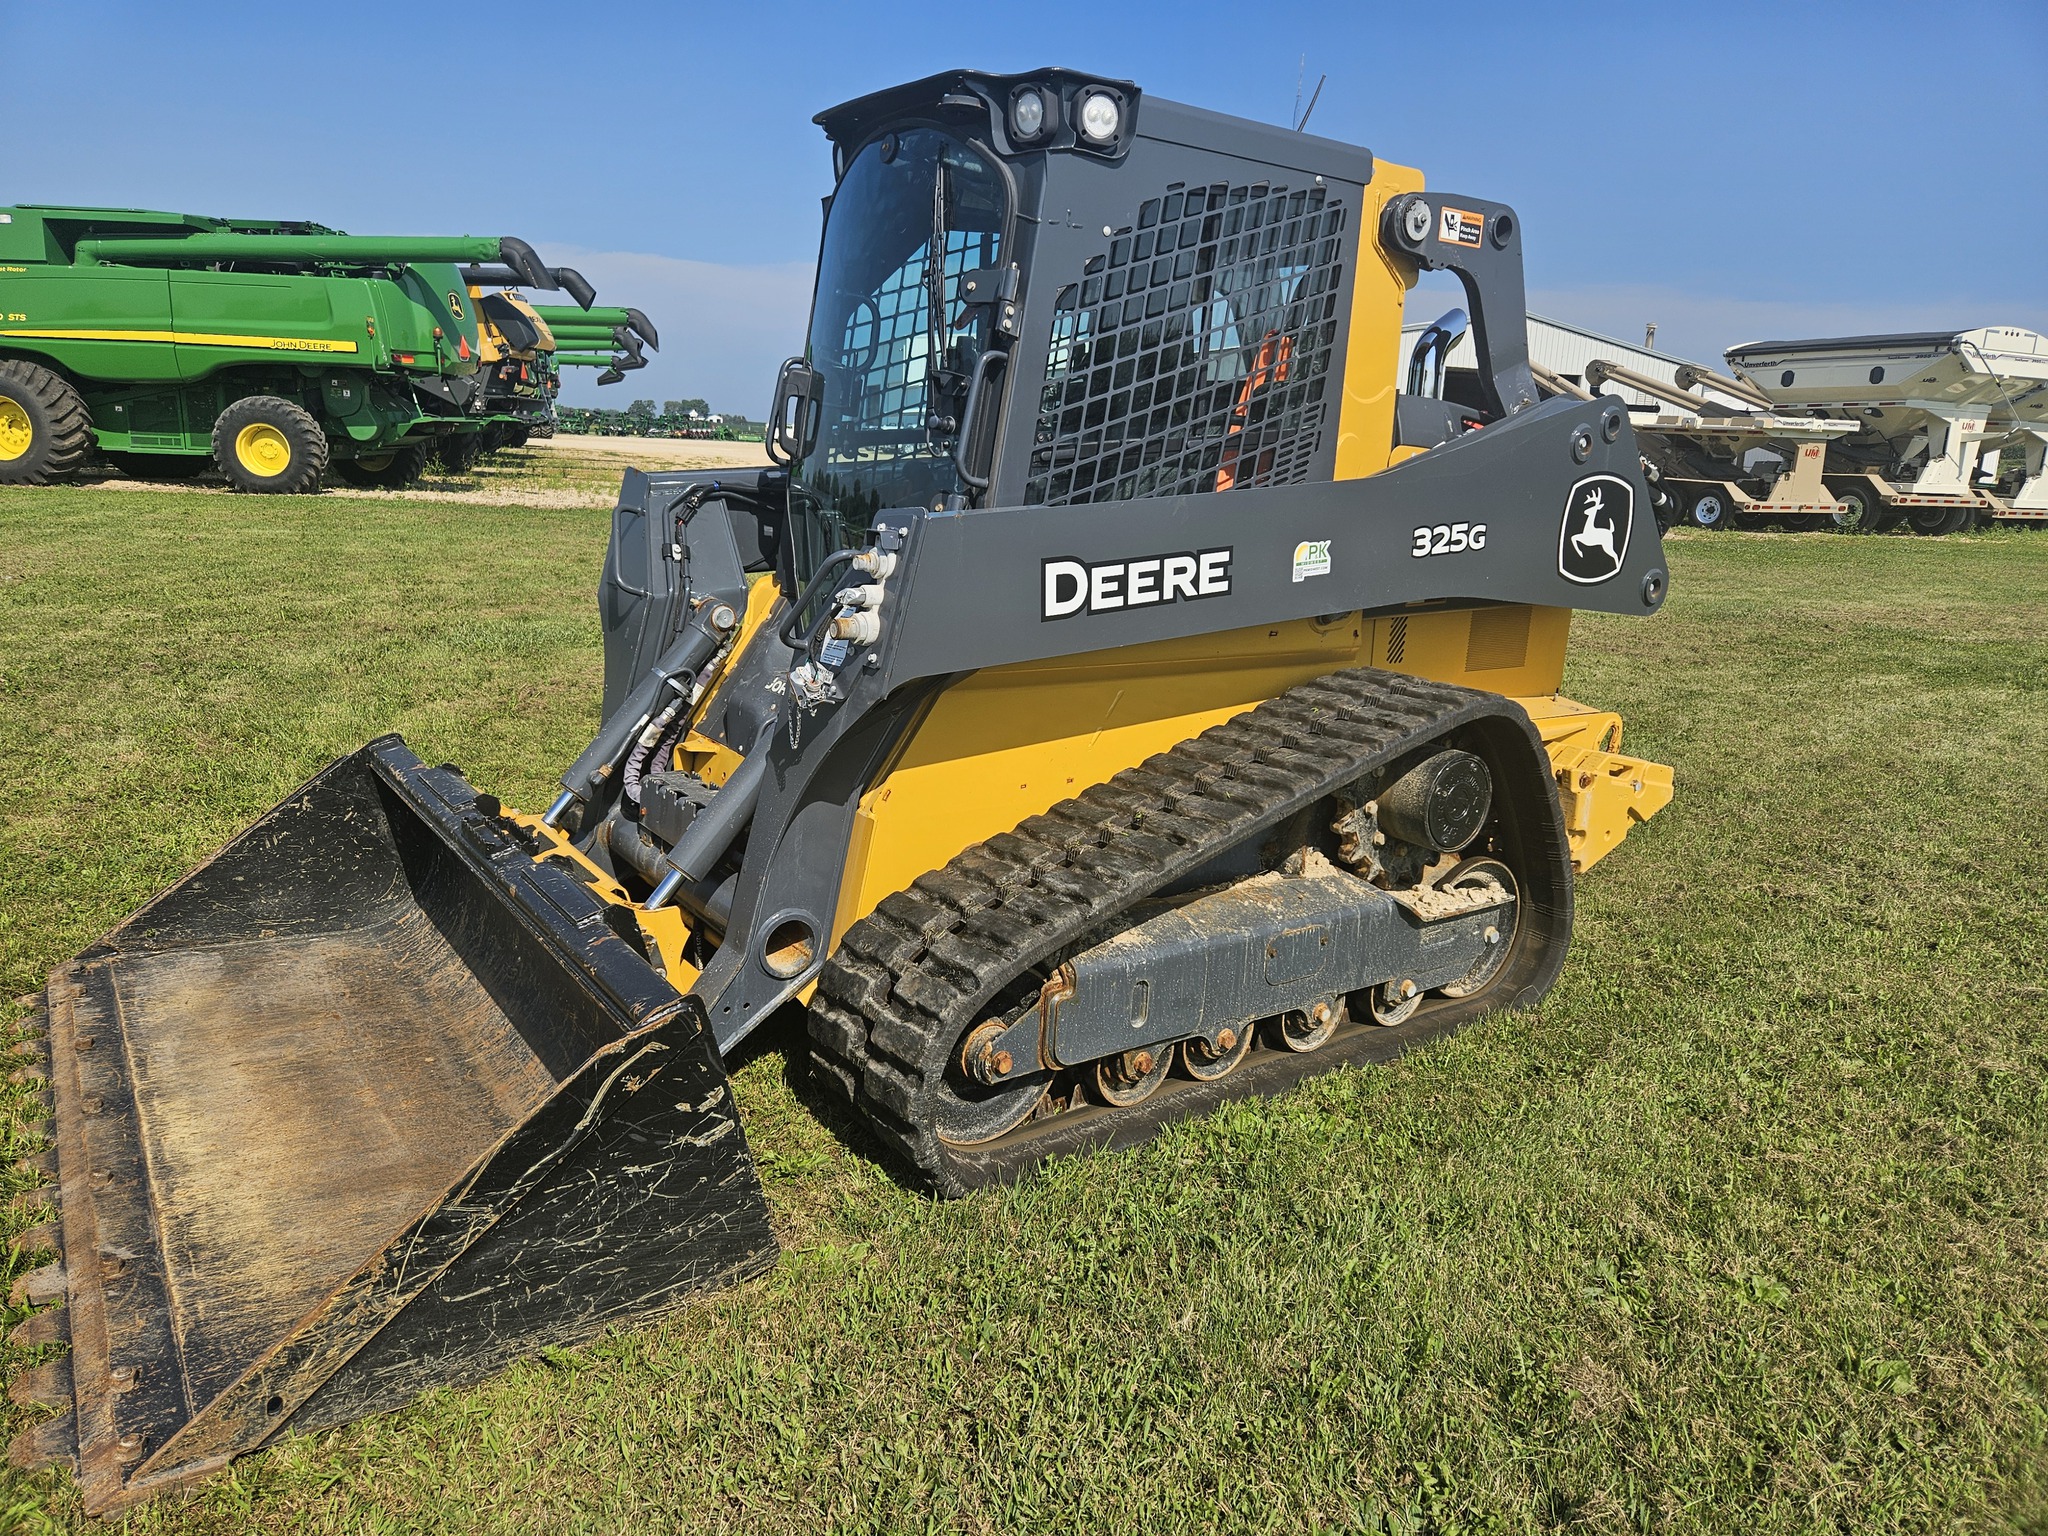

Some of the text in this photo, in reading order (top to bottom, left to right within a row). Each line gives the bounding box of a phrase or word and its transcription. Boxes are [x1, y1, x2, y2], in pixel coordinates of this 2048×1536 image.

[8, 313, 27, 321] STS
[271, 340, 332, 350] JOHN DEERE
[1805, 447, 1820, 458] UM
[1411, 522, 1488, 558] 325G
[1308, 543, 1328, 560] PK
[1043, 549, 1231, 619] DEERE
